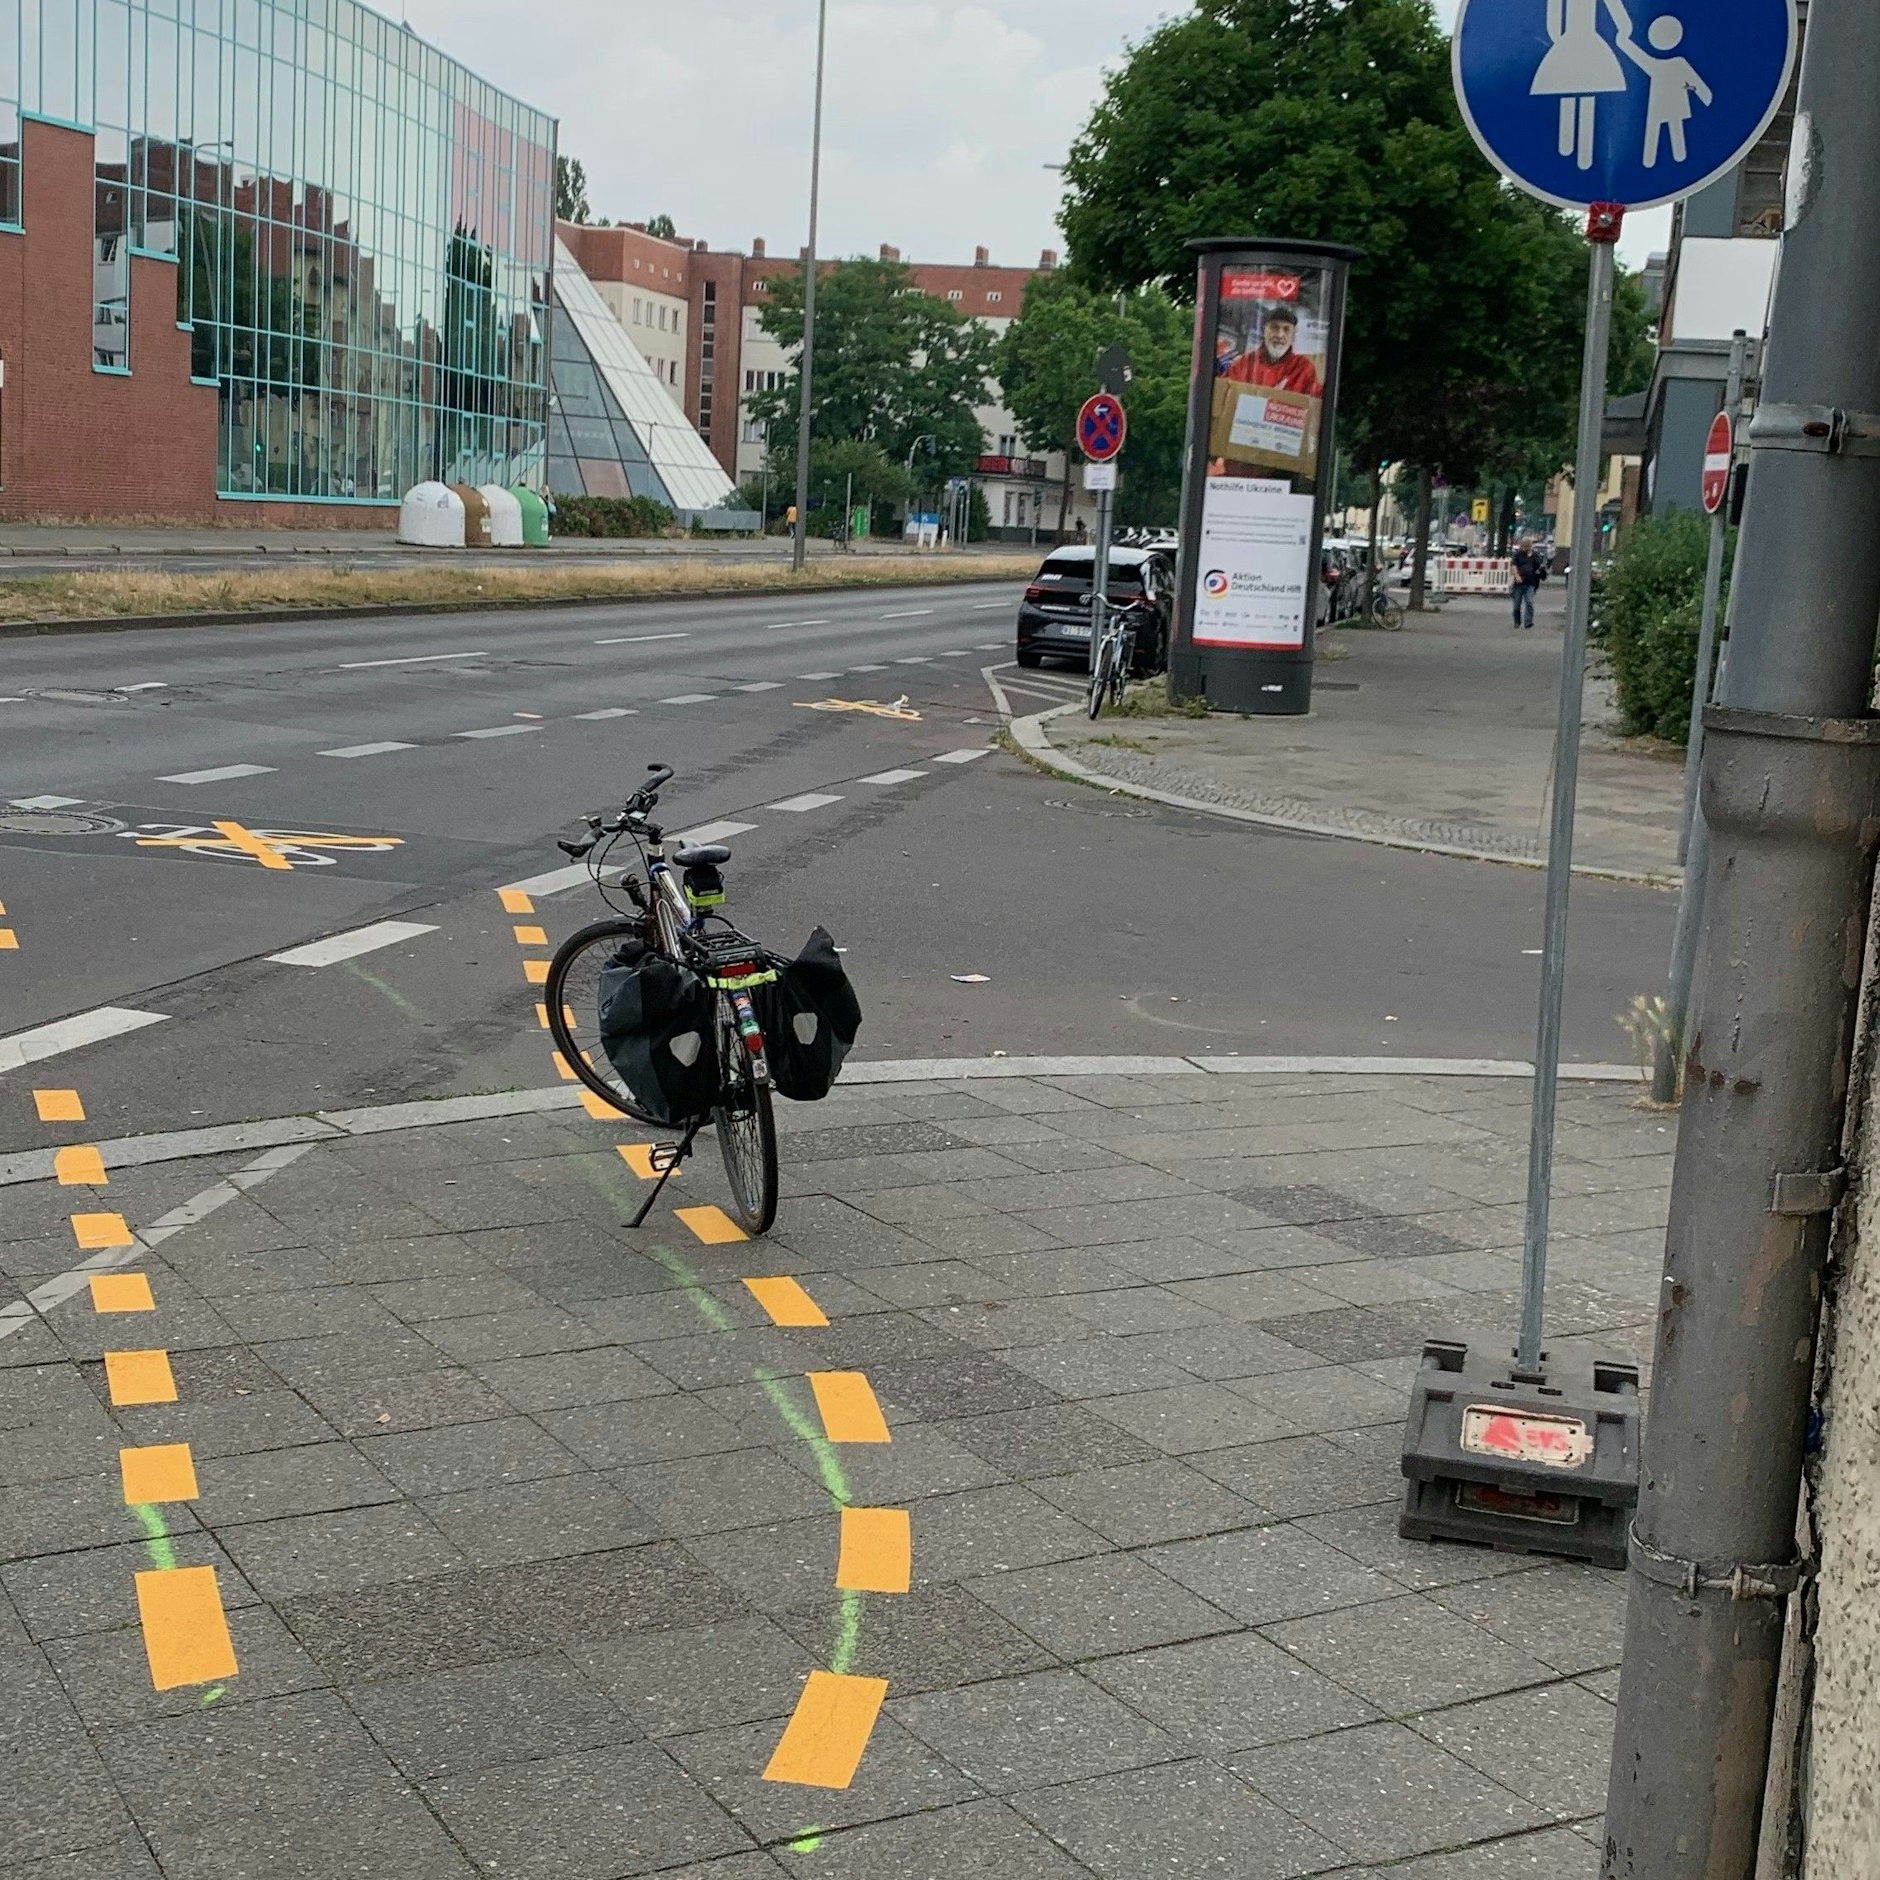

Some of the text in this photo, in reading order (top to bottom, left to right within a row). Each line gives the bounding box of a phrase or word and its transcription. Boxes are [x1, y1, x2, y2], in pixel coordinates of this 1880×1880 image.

[1209, 482, 1283, 494] Nothilfe Ukraine
[1232, 573, 1263, 582] Aktion
[1231, 582, 1286, 593] Deutschland
